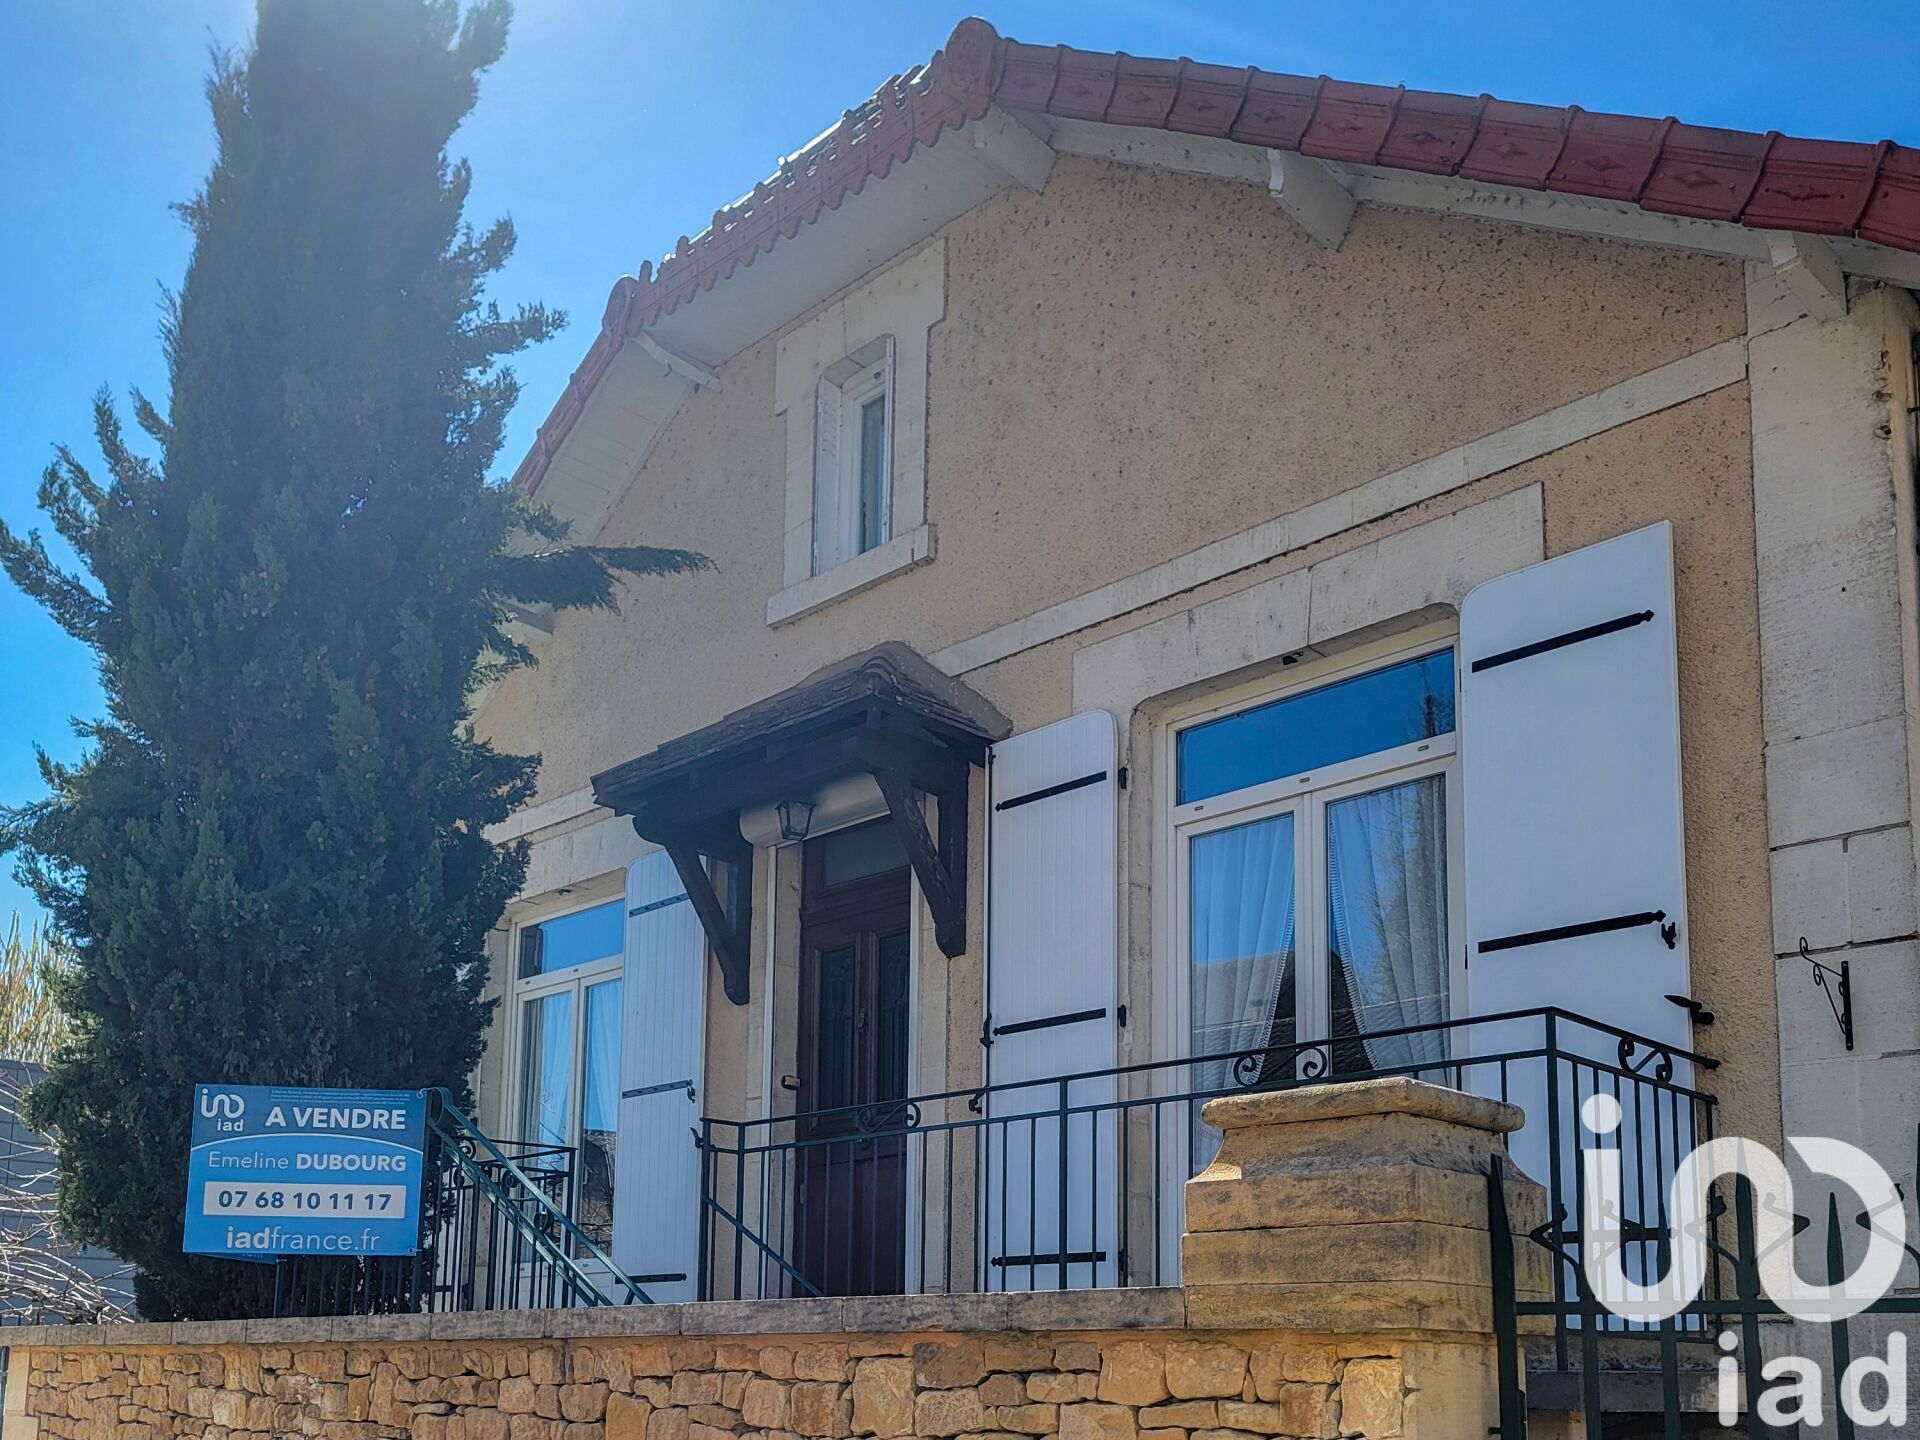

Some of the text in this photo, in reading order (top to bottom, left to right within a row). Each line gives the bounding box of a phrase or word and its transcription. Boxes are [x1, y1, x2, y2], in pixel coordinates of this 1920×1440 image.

[217, 1119, 243, 1132] iad
[265, 1107, 406, 1130] A VENDRE
[209, 1151, 406, 1172] Emeline DUBOURG
[218, 1190, 392, 1211] 07 68 10 11 17
[226, 1226, 380, 1251] iadfrance.fr
